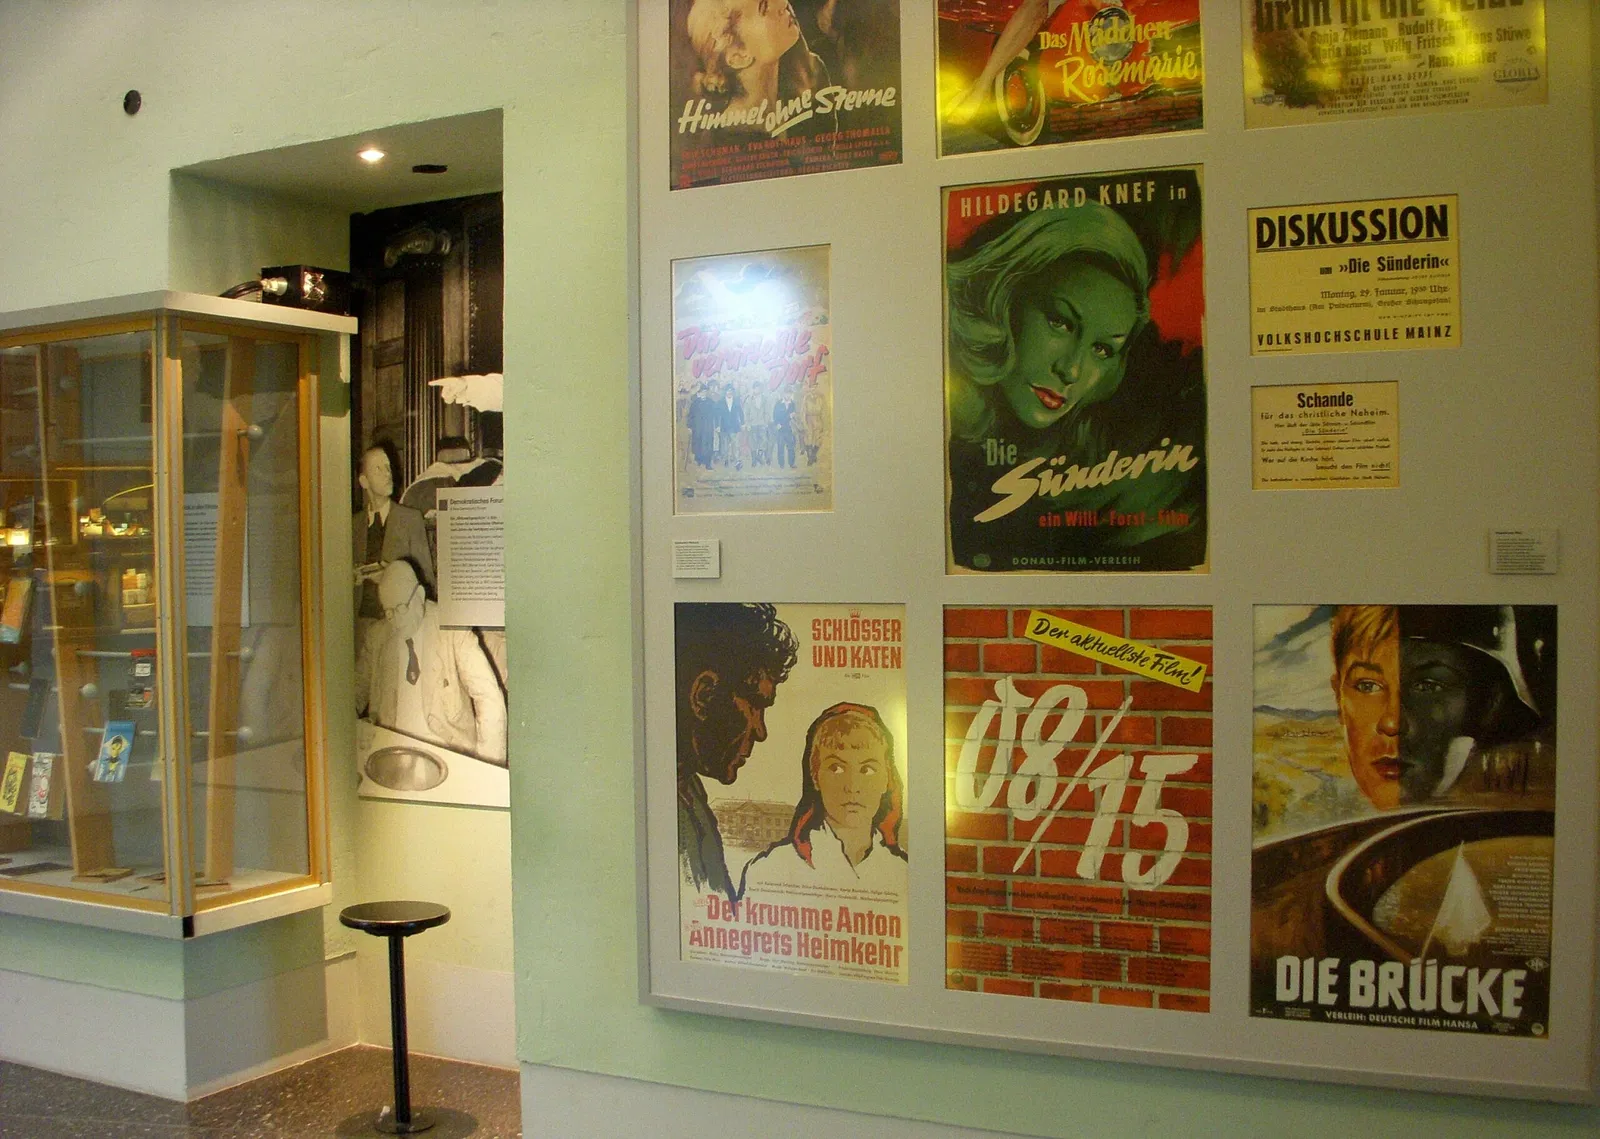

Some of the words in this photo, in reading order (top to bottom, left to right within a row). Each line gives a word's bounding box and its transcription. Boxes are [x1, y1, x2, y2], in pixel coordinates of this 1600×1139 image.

[1039, 31, 1068, 50] Das
[1065, 15, 1173, 56] Mädchen
[1398, 20, 1436, 36] Rudolf
[1055, 45, 1198, 104] Rosemarie
[678, 98, 768, 134] Himmel
[766, 88, 812, 133] ohne
[815, 85, 896, 114] Sterne
[960, 185, 1088, 218] HILDEGARD
[1100, 180, 1157, 206] KNEF
[1169, 184, 1187, 201] in
[1256, 204, 1449, 249] DISKUSSION
[1257, 327, 1399, 347] VOLKSHOCHSCHULE
[1405, 325, 1452, 341] MAINZ
[1260, 411, 1273, 420] für
[1278, 410, 1294, 419] das
[1298, 410, 1347, 419] christliche
[1297, 391, 1354, 408] Schande
[985, 437, 1018, 466] Die
[973, 436, 1199, 524] Sünderin
[1038, 510, 1061, 528] ein
[812, 645, 847, 668] UND
[850, 645, 902, 669] KATEN
[1032, 617, 1069, 640] Der
[1069, 632, 1151, 668] aktuellste
[1149, 653, 1203, 685] Film!
[955, 675, 1199, 891] 08/15
[707, 895, 743, 923] Der
[745, 897, 833, 932] krumme
[836, 905, 901, 938] Anton
[689, 920, 792, 956] Annegrets
[796, 931, 904, 968] Heimkehr
[1275, 955, 1341, 1005] DIE
[1349, 957, 1528, 1018] BRÜCKE
[1325, 1010, 1367, 1022] VERLEIH:
[1368, 1013, 1417, 1025] DEUTSCHE
[1418, 1016, 1441, 1028] FILM
[1442, 1018, 1478, 1031] HANSA
